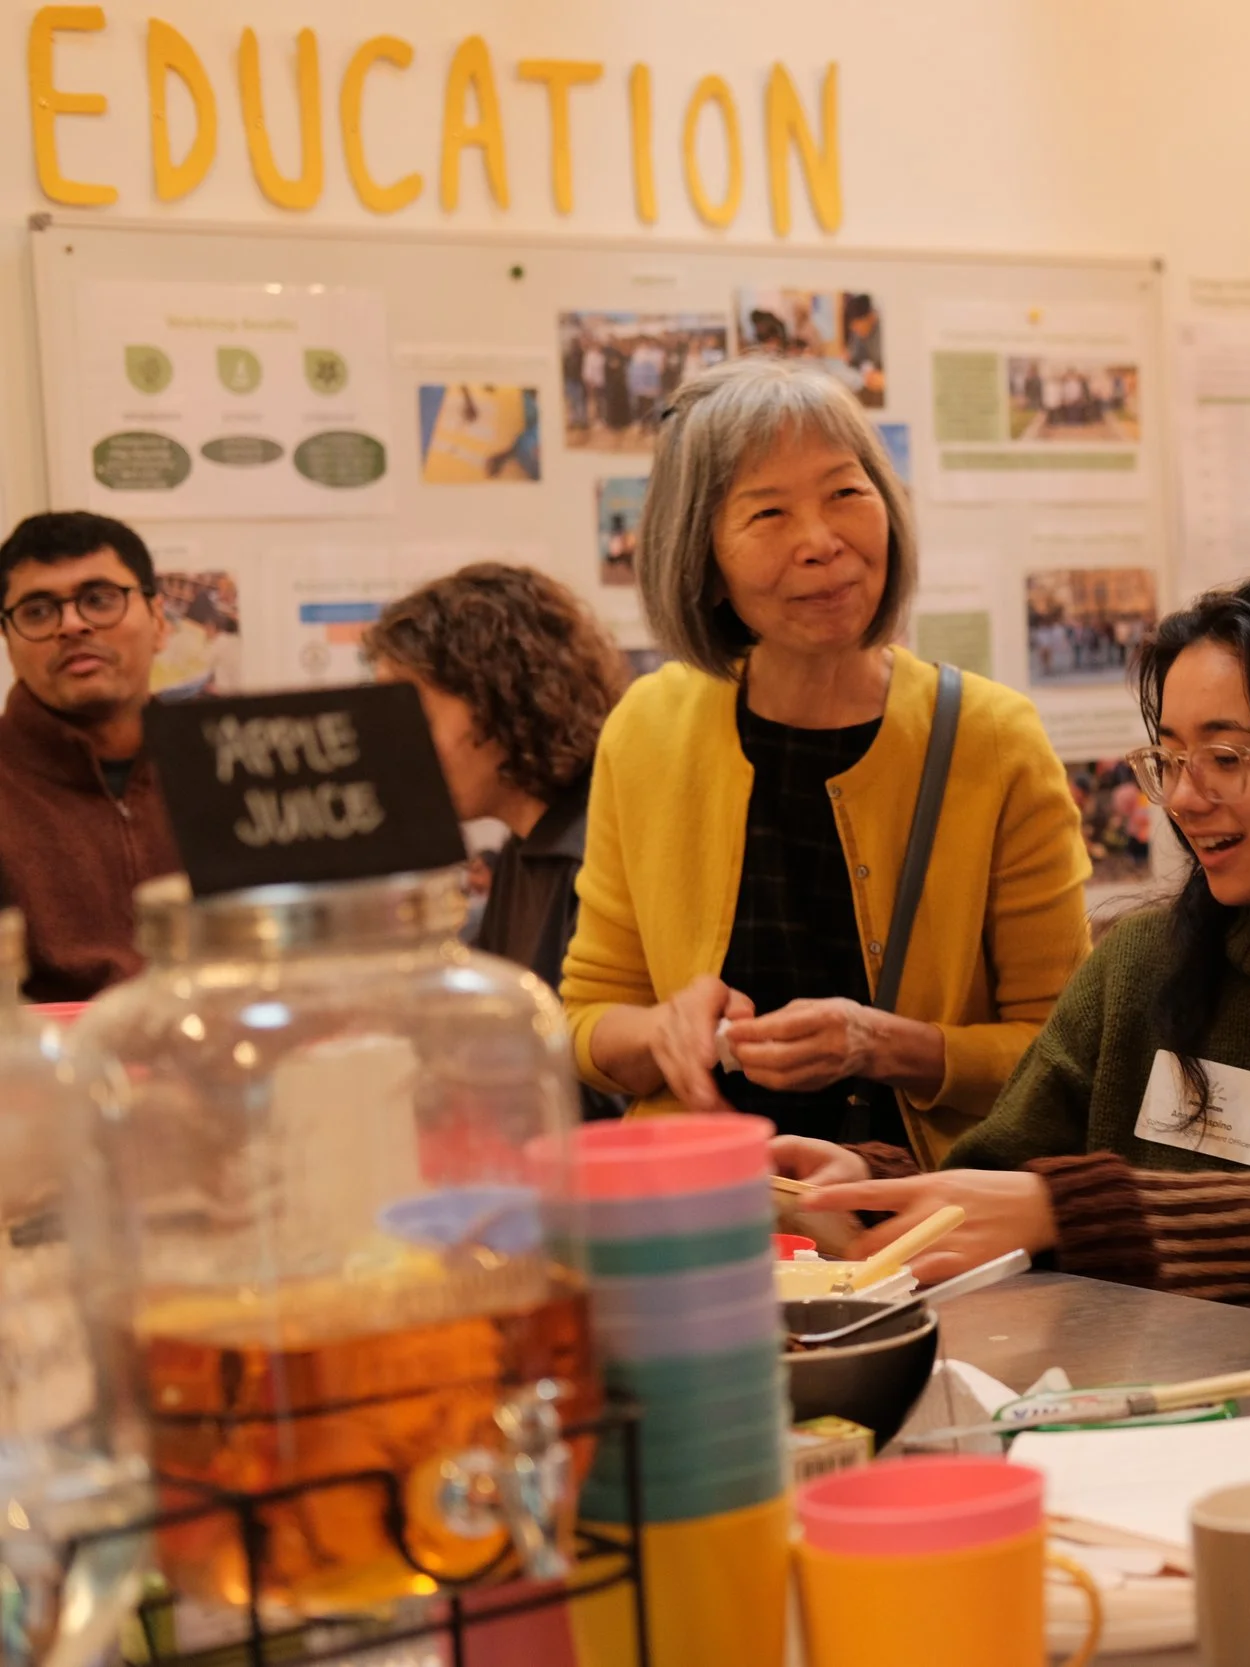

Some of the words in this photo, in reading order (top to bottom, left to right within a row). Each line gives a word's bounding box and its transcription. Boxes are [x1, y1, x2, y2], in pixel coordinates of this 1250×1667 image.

[27, 5, 842, 237] EDUCATION
[202, 711, 359, 783] APPLE
[233, 780, 386, 848] JUICE
